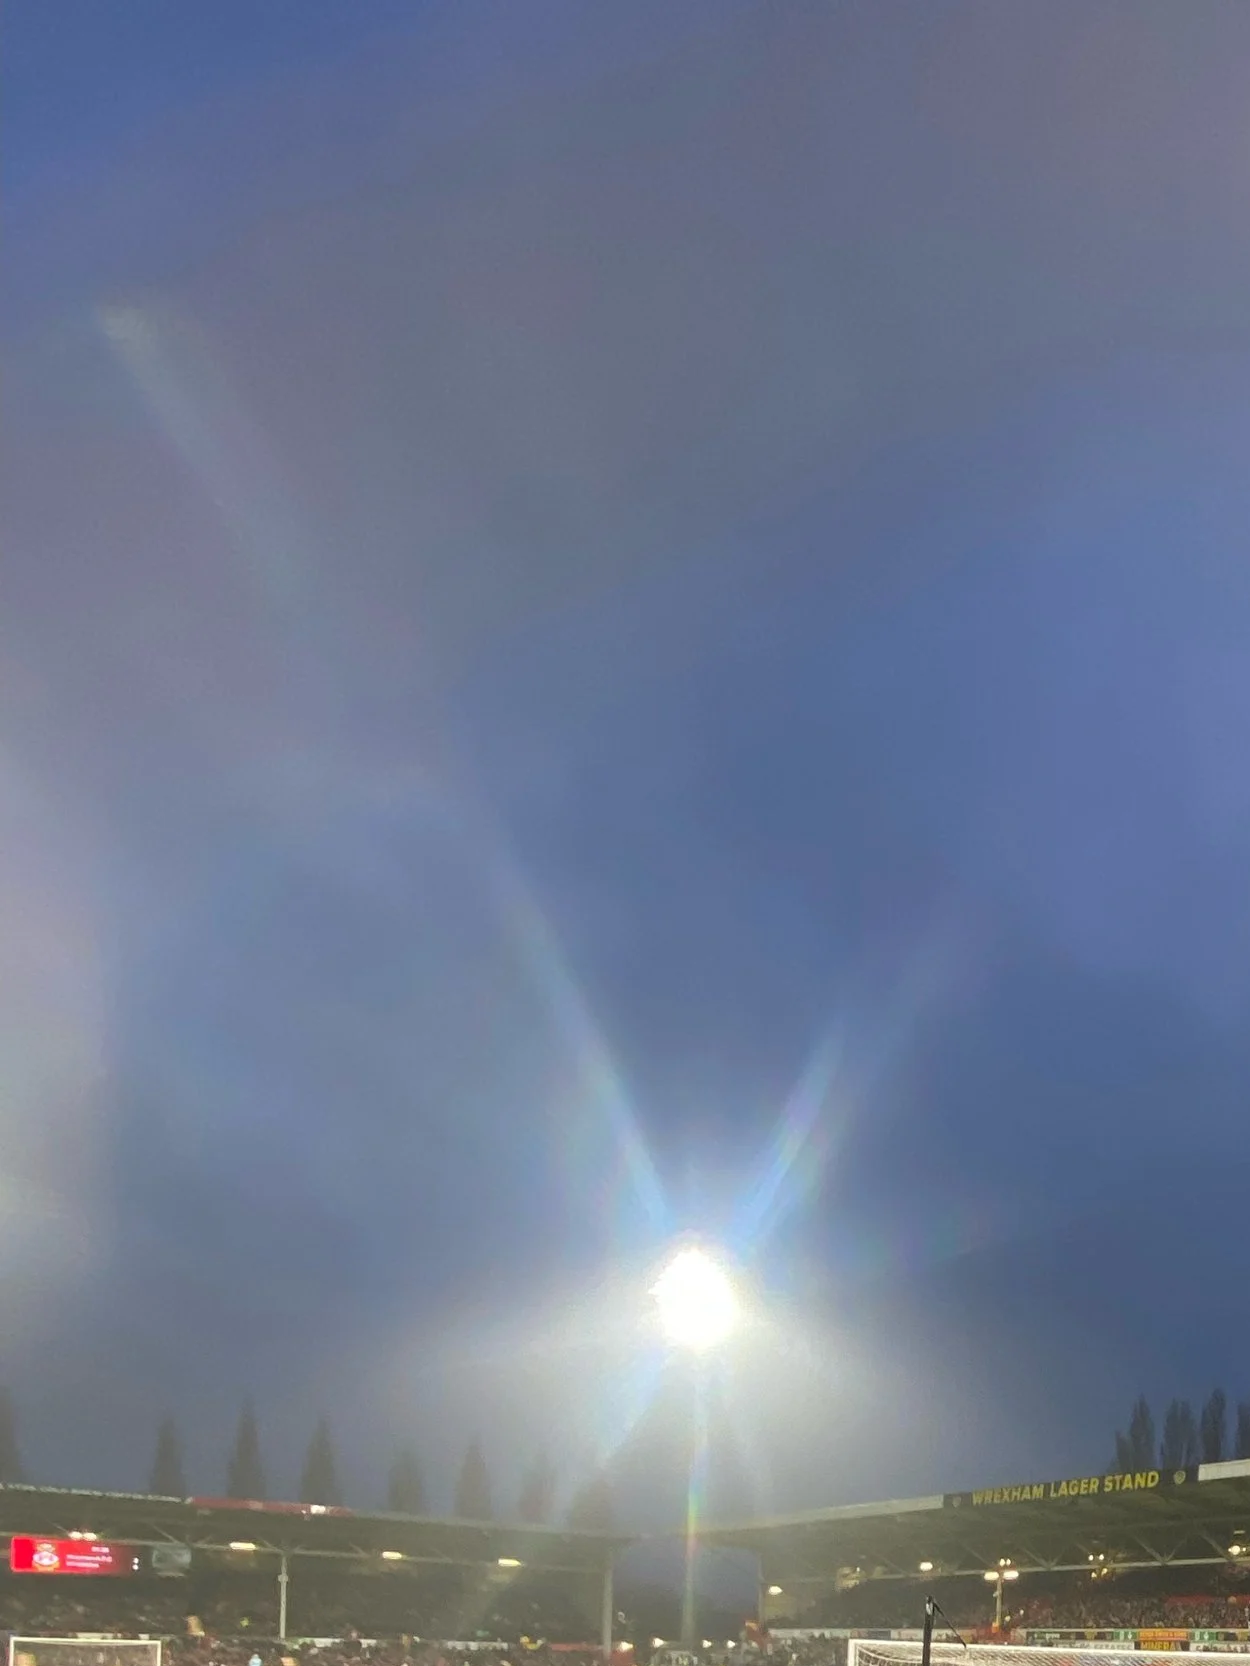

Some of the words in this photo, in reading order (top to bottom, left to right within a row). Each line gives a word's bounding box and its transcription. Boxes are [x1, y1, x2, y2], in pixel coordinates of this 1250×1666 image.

[972, 1484, 1044, 1506] WREXHAM
[1050, 1478, 1098, 1498] LAGER
[1104, 1471, 1160, 1493] STAND
